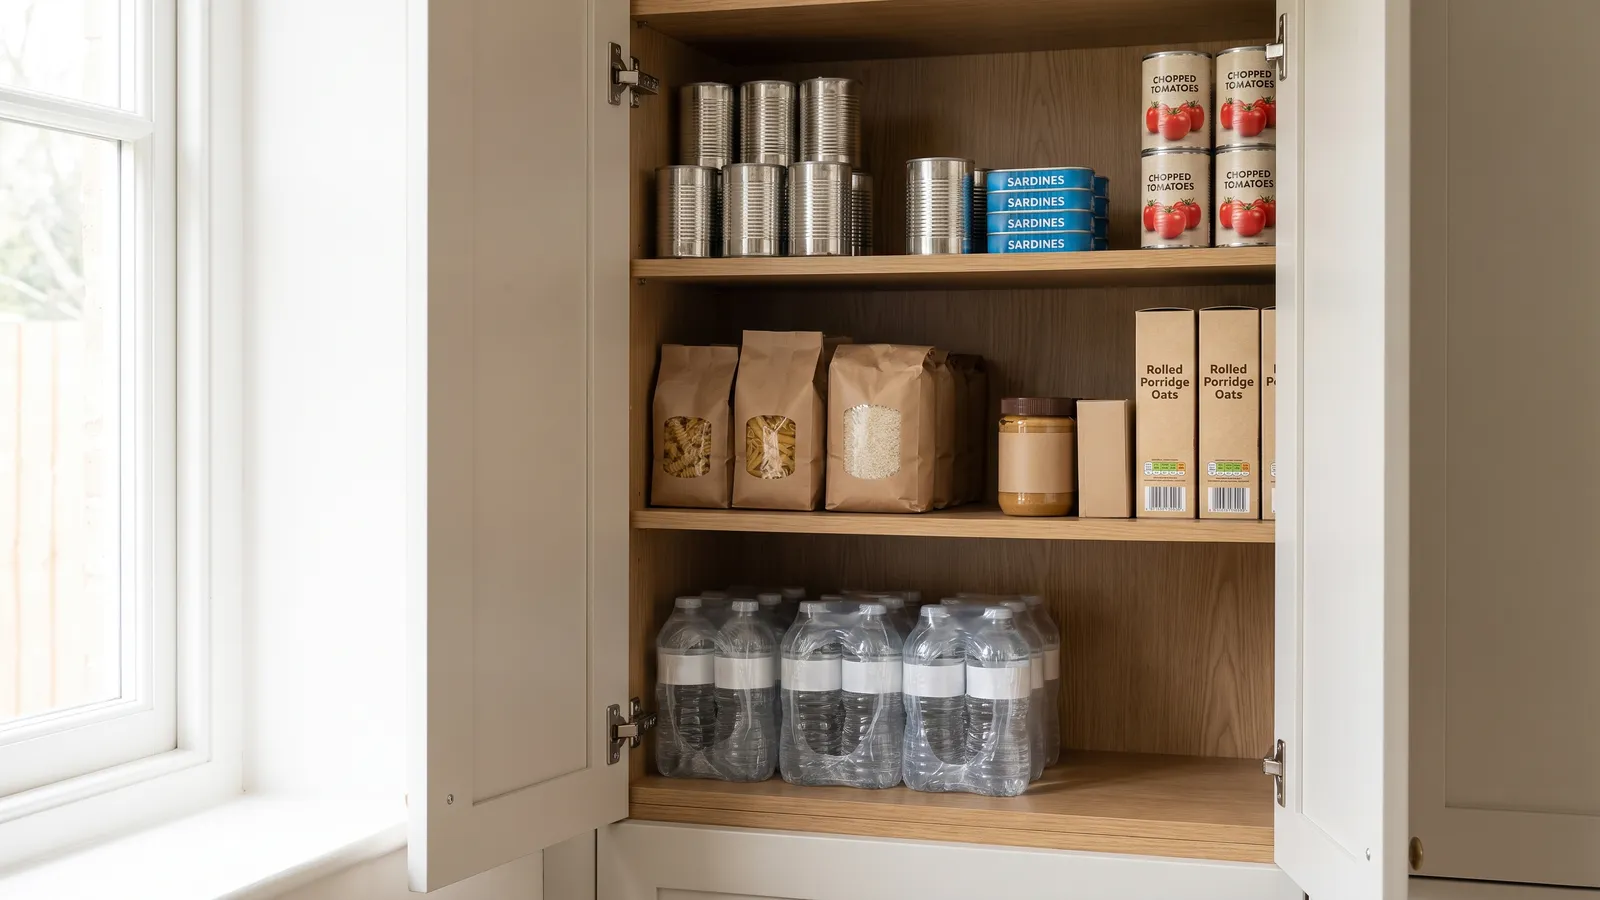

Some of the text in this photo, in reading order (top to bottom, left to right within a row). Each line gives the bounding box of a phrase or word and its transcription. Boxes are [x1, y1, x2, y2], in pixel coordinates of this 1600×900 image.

[1153, 75, 1196, 84] CHOPPED
[1227, 70, 1272, 80] CHOPPED
[1151, 84, 1199, 94] TOMATOES
[1225, 80, 1274, 90] TOMATOES
[1148, 173, 1191, 182] CHOPPED
[1226, 170, 1271, 179] CHOPPED
[1007, 175, 1064, 187] SARDINES
[1224, 180, 1274, 189] TOMATOES
[1147, 183, 1194, 192] TOMATOES
[1008, 196, 1065, 207] SARDINES
[1008, 218, 1065, 229] SARDINES
[1008, 239, 1065, 249] SARDINES
[1147, 364, 1183, 374] Rolled
[1210, 363, 1247, 374] Rolled
[1140, 377, 1190, 389] Porridge
[1204, 376, 1254, 389] Porridge
[1151, 390, 1179, 399] Oats
[1215, 390, 1243, 399] Oats
